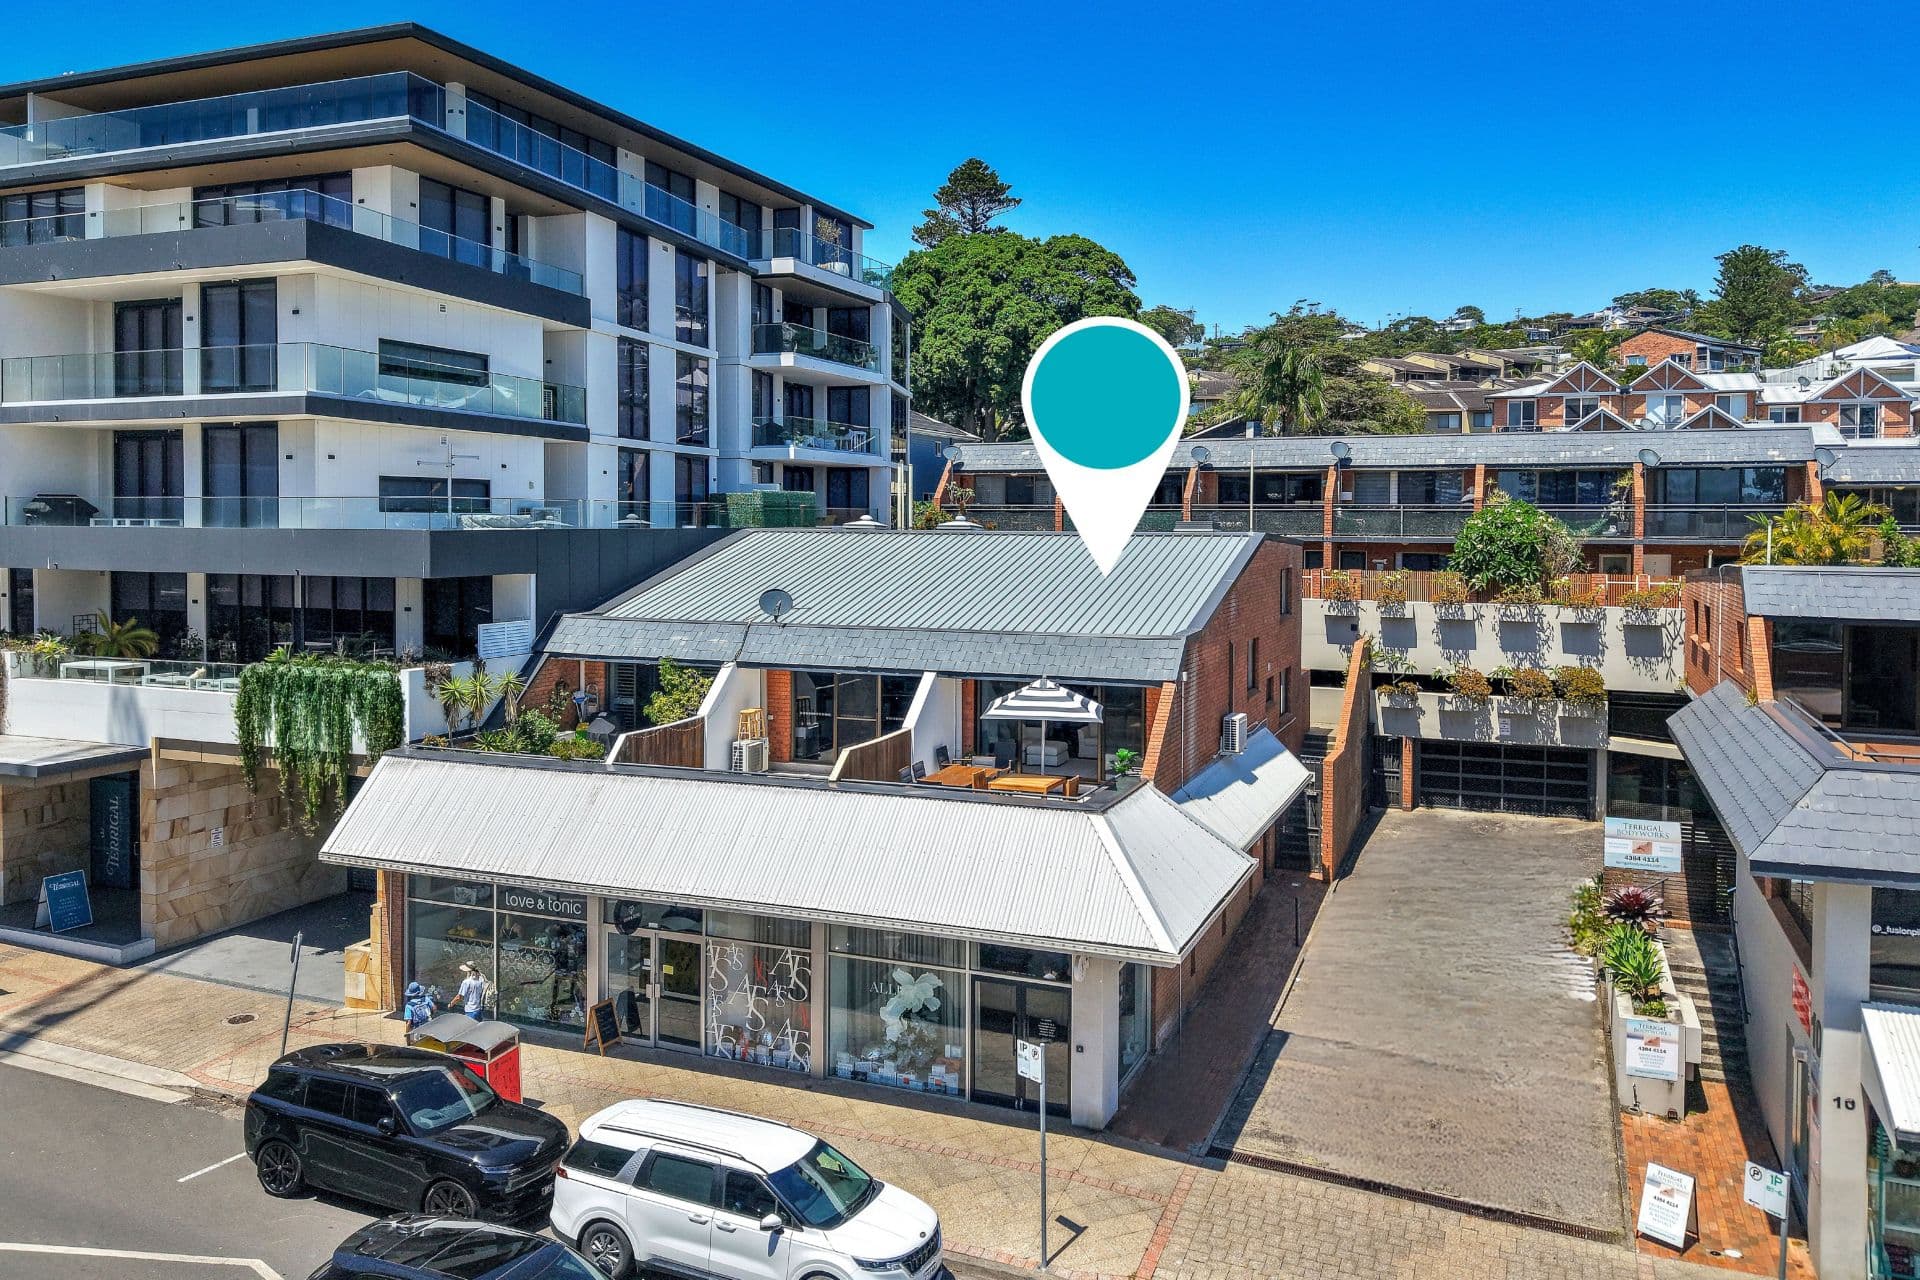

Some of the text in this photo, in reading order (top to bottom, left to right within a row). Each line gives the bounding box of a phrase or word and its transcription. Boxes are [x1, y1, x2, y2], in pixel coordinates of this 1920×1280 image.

[1623, 822, 1663, 832] TERRIGAL
[1617, 828, 1670, 839] BODYWORKS
[505, 891, 582, 915] love & tonic
